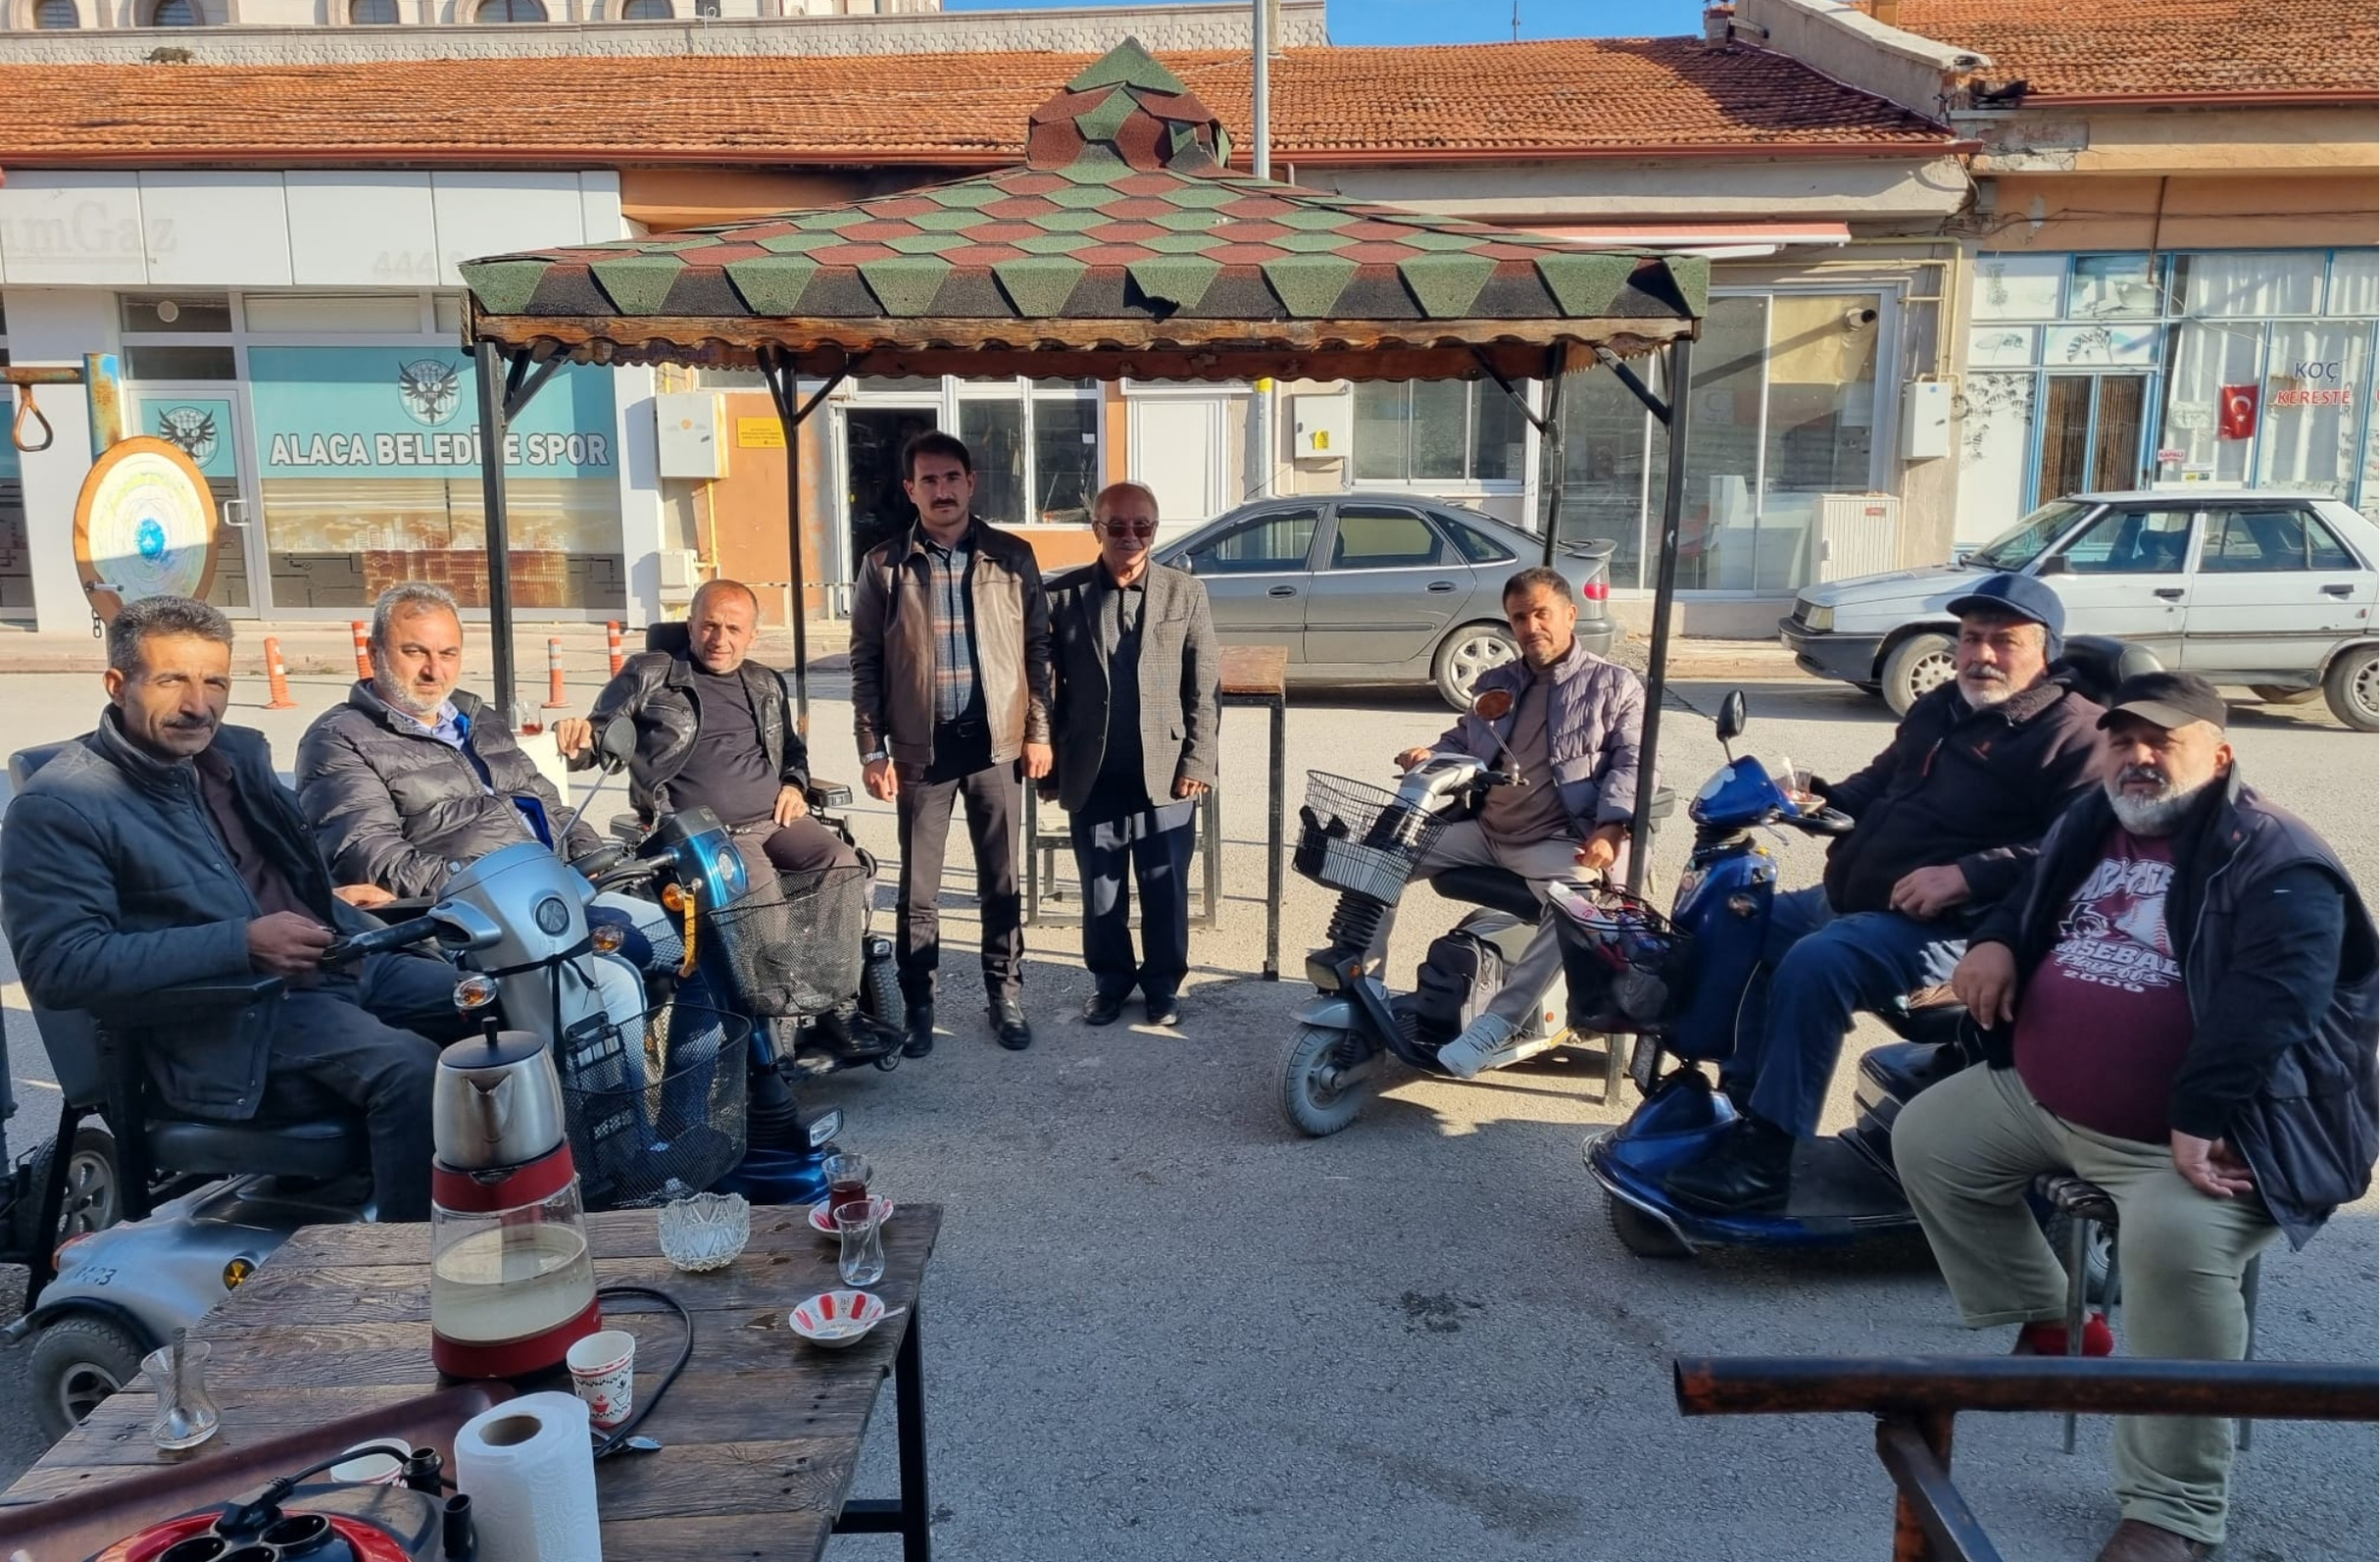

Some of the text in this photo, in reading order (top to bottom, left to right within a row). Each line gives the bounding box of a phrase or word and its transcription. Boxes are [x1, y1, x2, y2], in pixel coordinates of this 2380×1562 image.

[2294, 361, 2339, 383] KOÇ
[2277, 389, 2352, 405] KERESTE
[270, 425, 611, 466] ALACA BELEDİE SPOR
